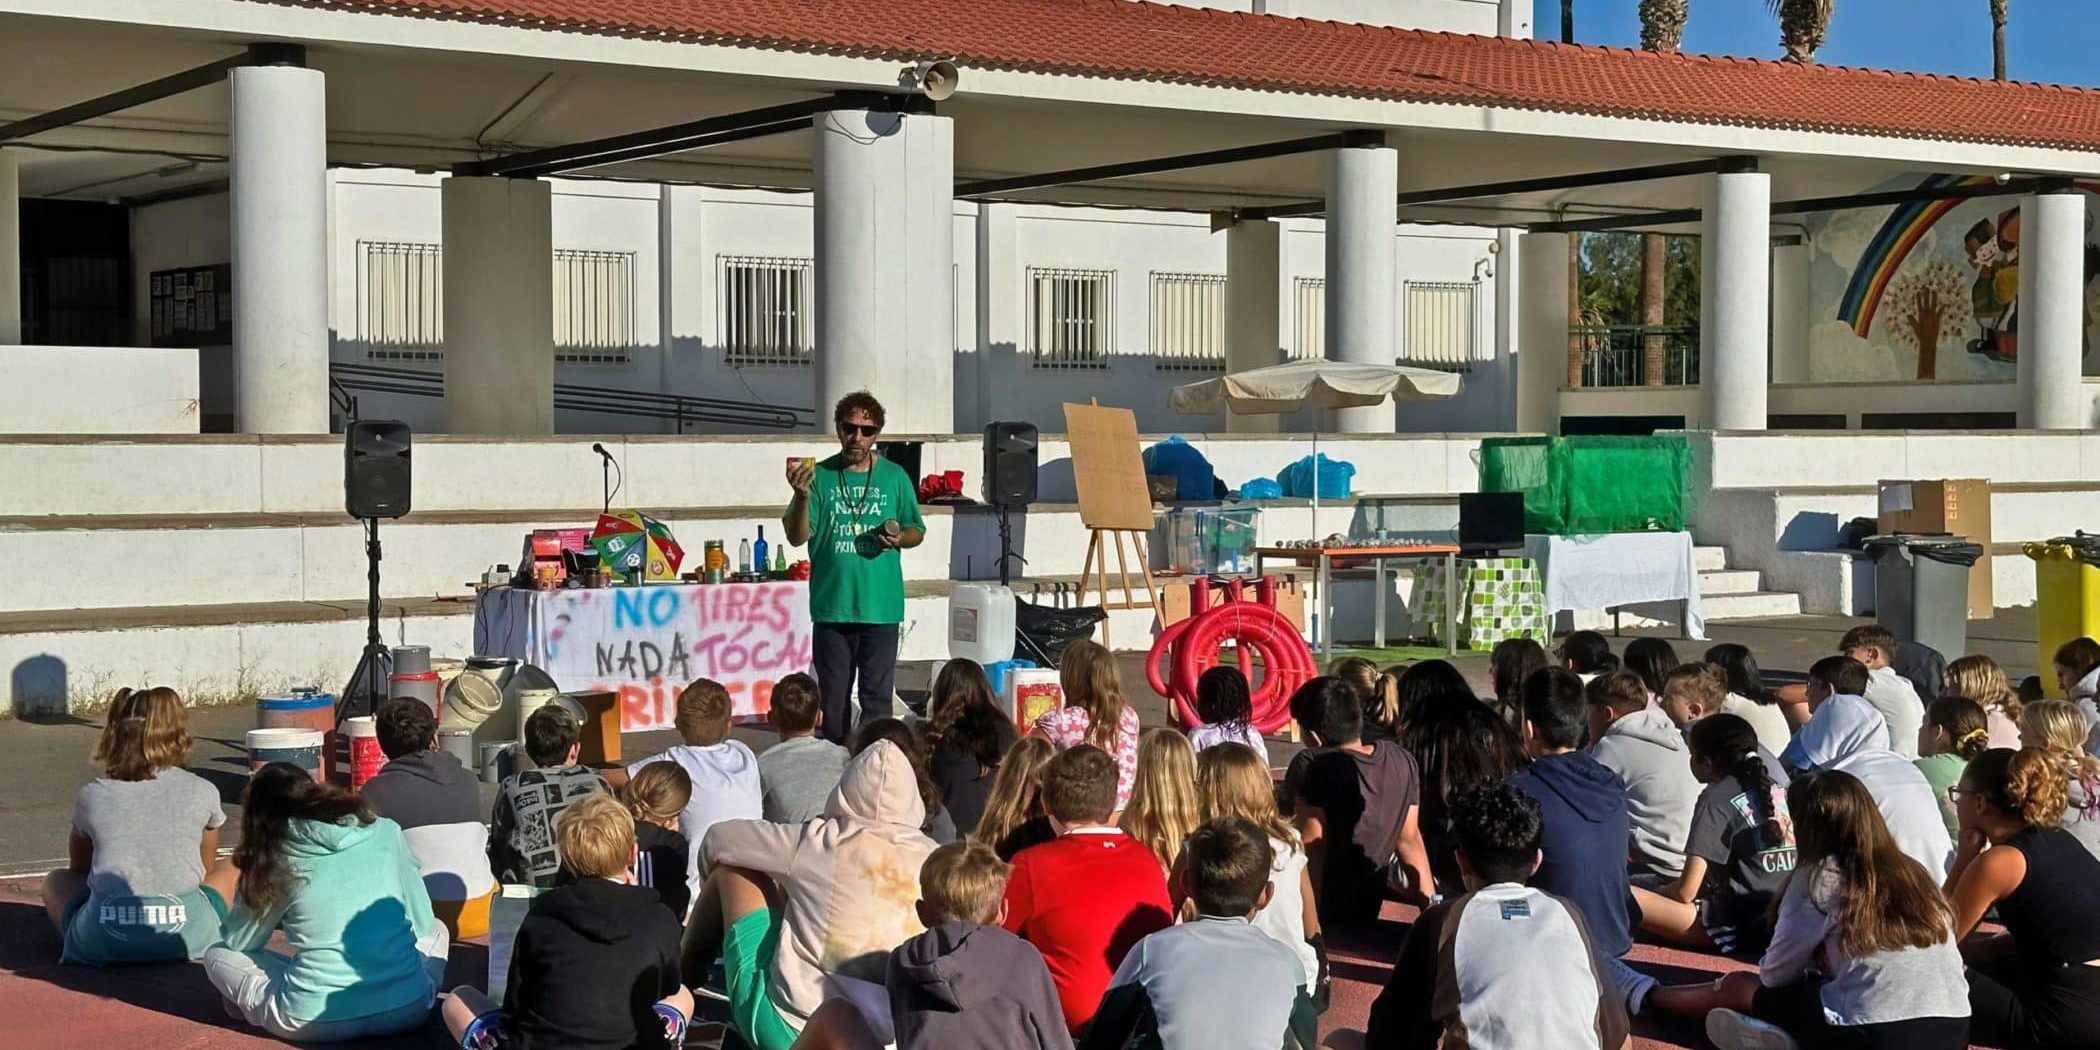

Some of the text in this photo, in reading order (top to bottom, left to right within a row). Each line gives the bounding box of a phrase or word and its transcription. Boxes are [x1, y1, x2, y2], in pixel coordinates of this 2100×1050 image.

[835, 501, 882, 516] NADA
[614, 585, 795, 632] NO TIRES
[596, 632, 690, 680] NADA
[99, 905, 187, 925] PUMA
